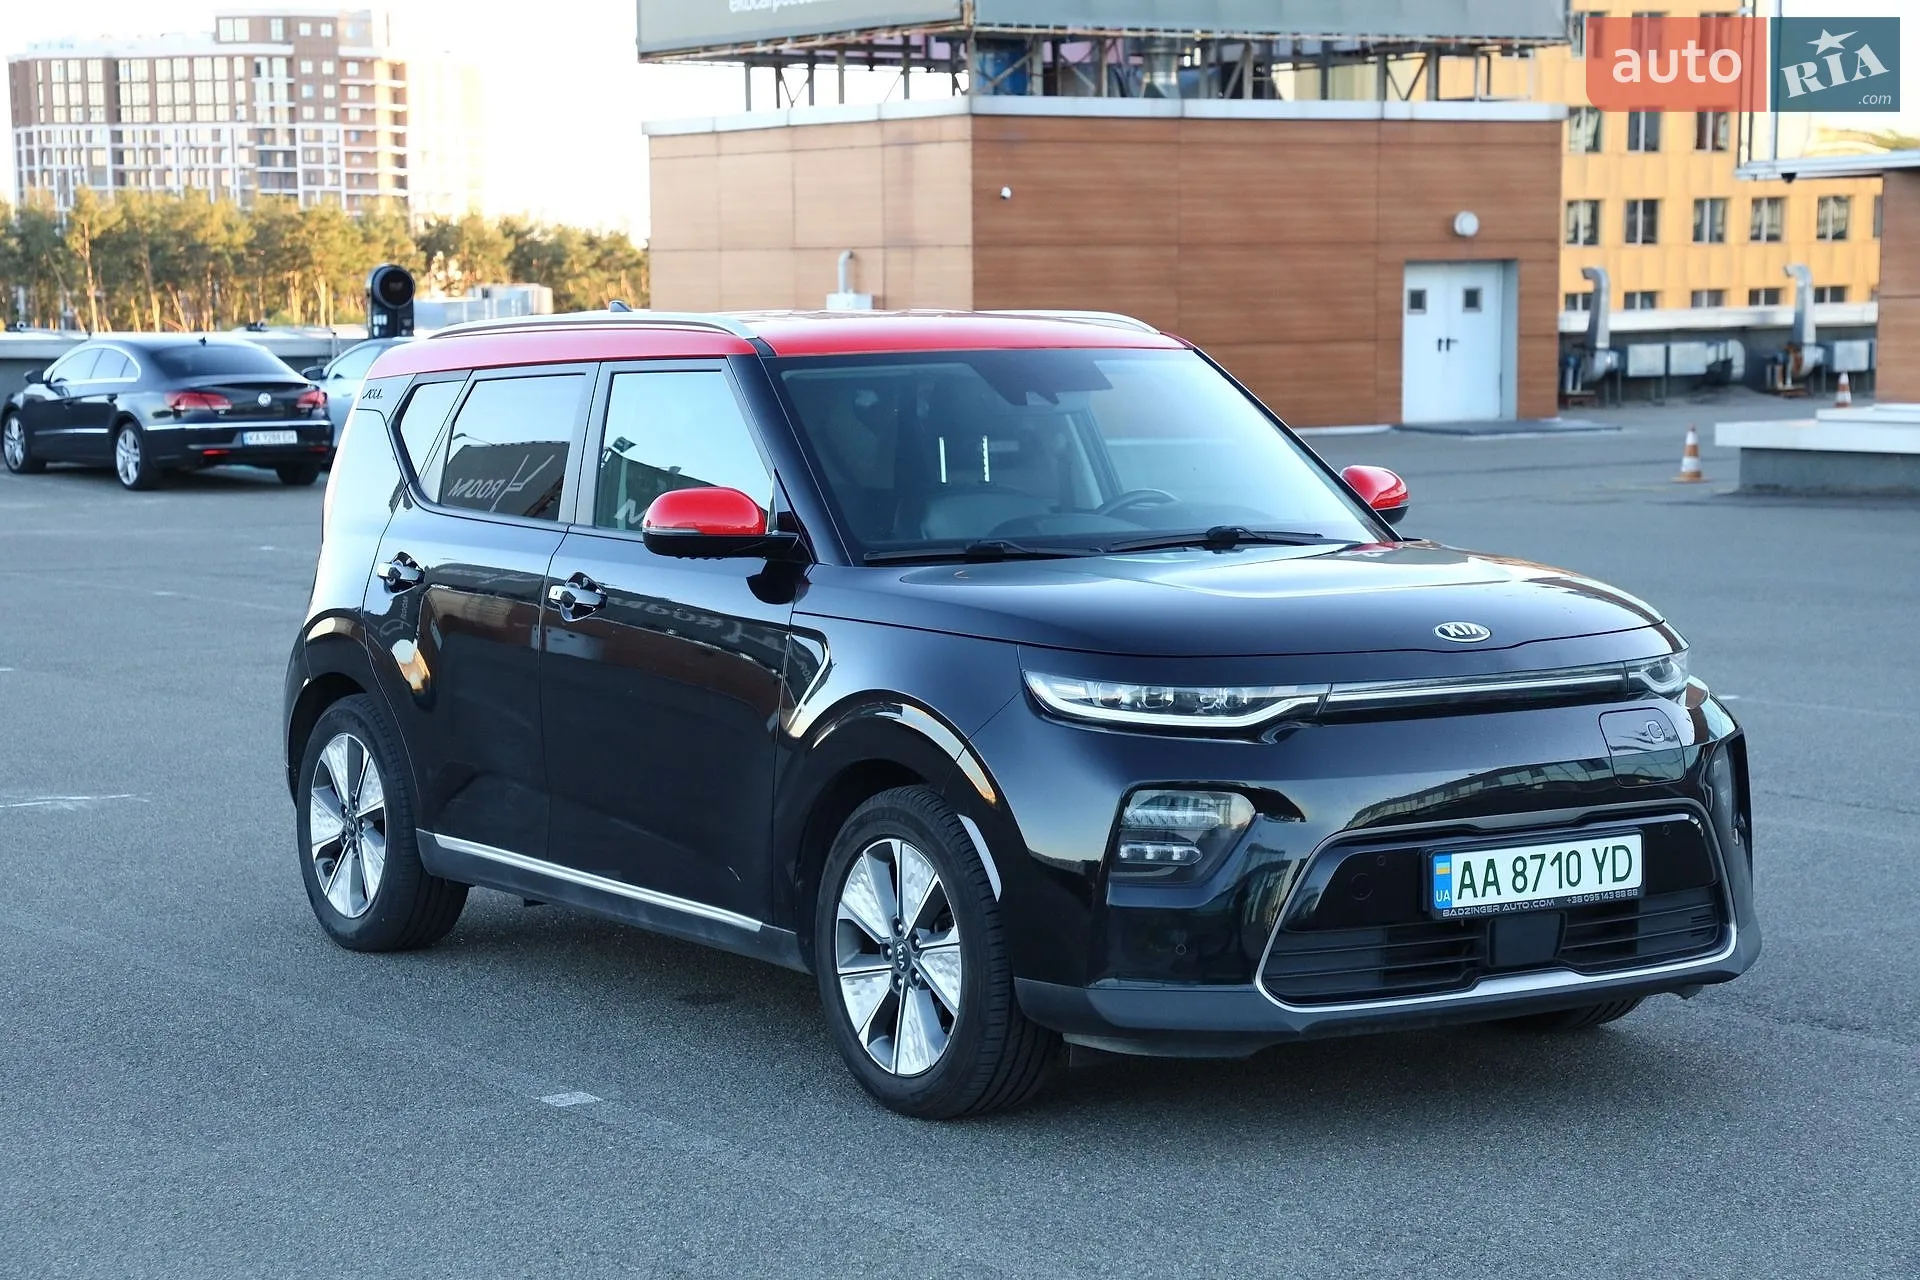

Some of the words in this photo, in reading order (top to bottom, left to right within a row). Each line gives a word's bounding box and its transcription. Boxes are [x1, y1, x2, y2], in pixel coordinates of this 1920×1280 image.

[1441, 623, 1486, 637] KIA
[1457, 858, 1502, 900] AA
[1512, 850, 1582, 893] 8710
[1592, 844, 1633, 885] YD
[1435, 889, 1451, 902] UA
[1442, 904, 1500, 917] BADZINGER
[1502, 899, 1555, 912] AUTO.COM
